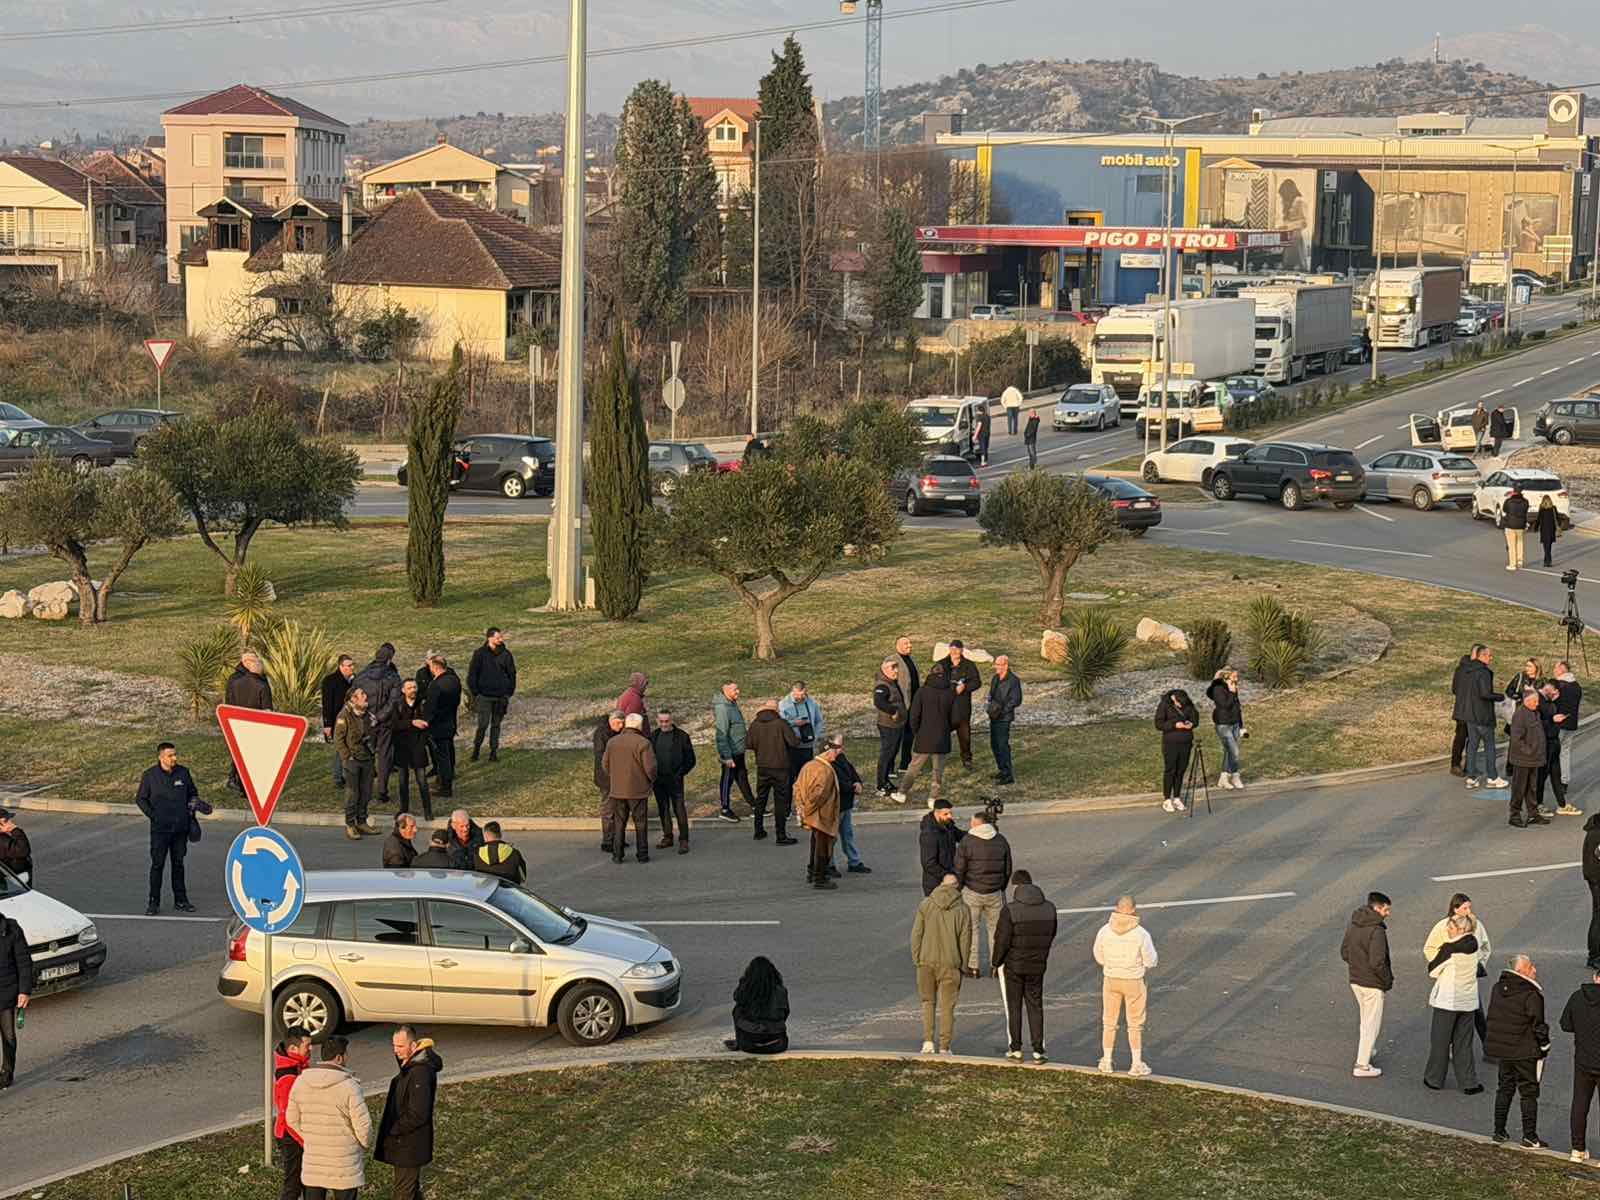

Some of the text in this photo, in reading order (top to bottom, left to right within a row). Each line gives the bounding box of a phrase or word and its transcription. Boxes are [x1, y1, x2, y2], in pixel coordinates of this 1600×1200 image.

[1101, 154, 1180, 167] mobil auto
[1084, 231, 1139, 246] PIGO
